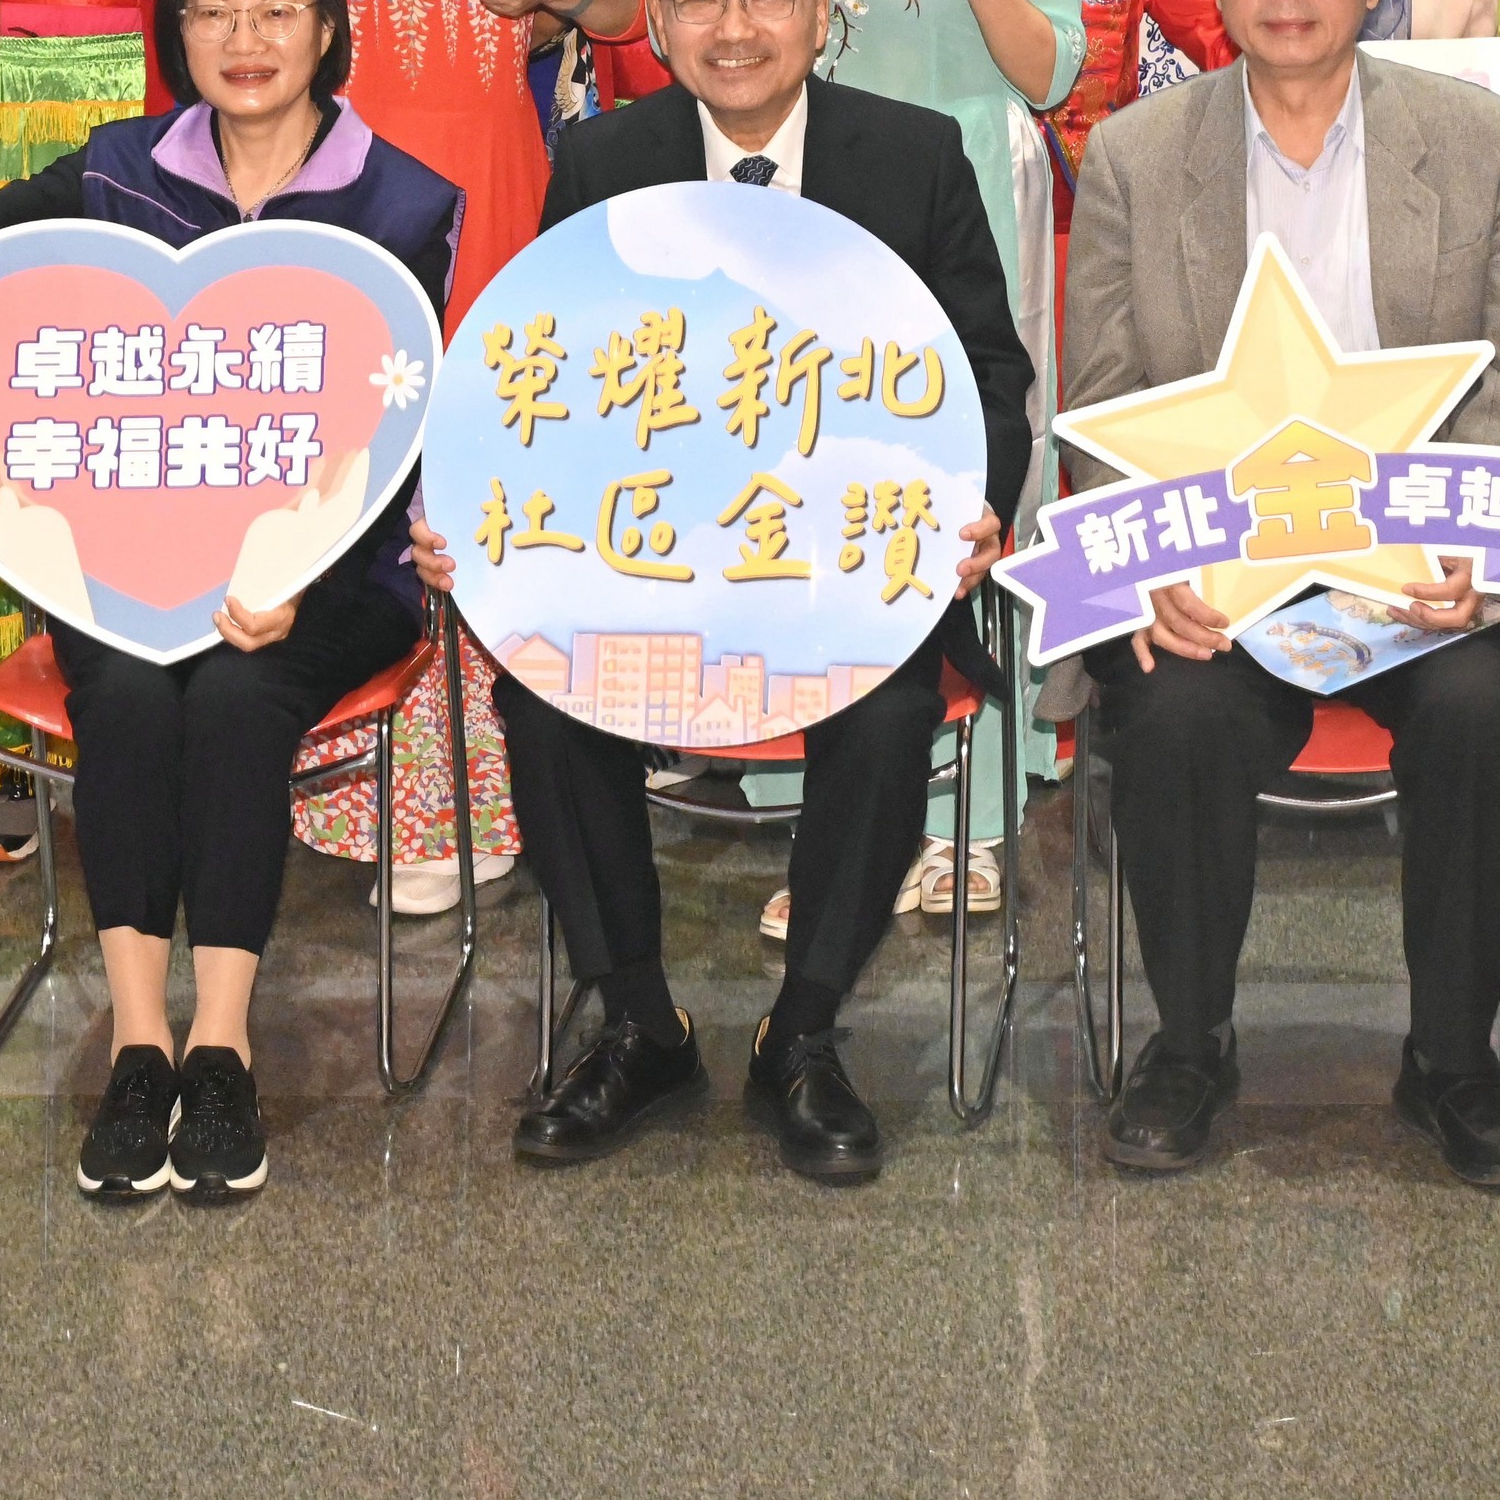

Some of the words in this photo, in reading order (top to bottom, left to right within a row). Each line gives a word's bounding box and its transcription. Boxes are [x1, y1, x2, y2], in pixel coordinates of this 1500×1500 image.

[8, 320, 327, 398] 卓越永續
[481, 305, 947, 456] 榮耀新北
[4, 412, 323, 490] 幸福共好
[474, 469, 940, 605] 社區金讚
